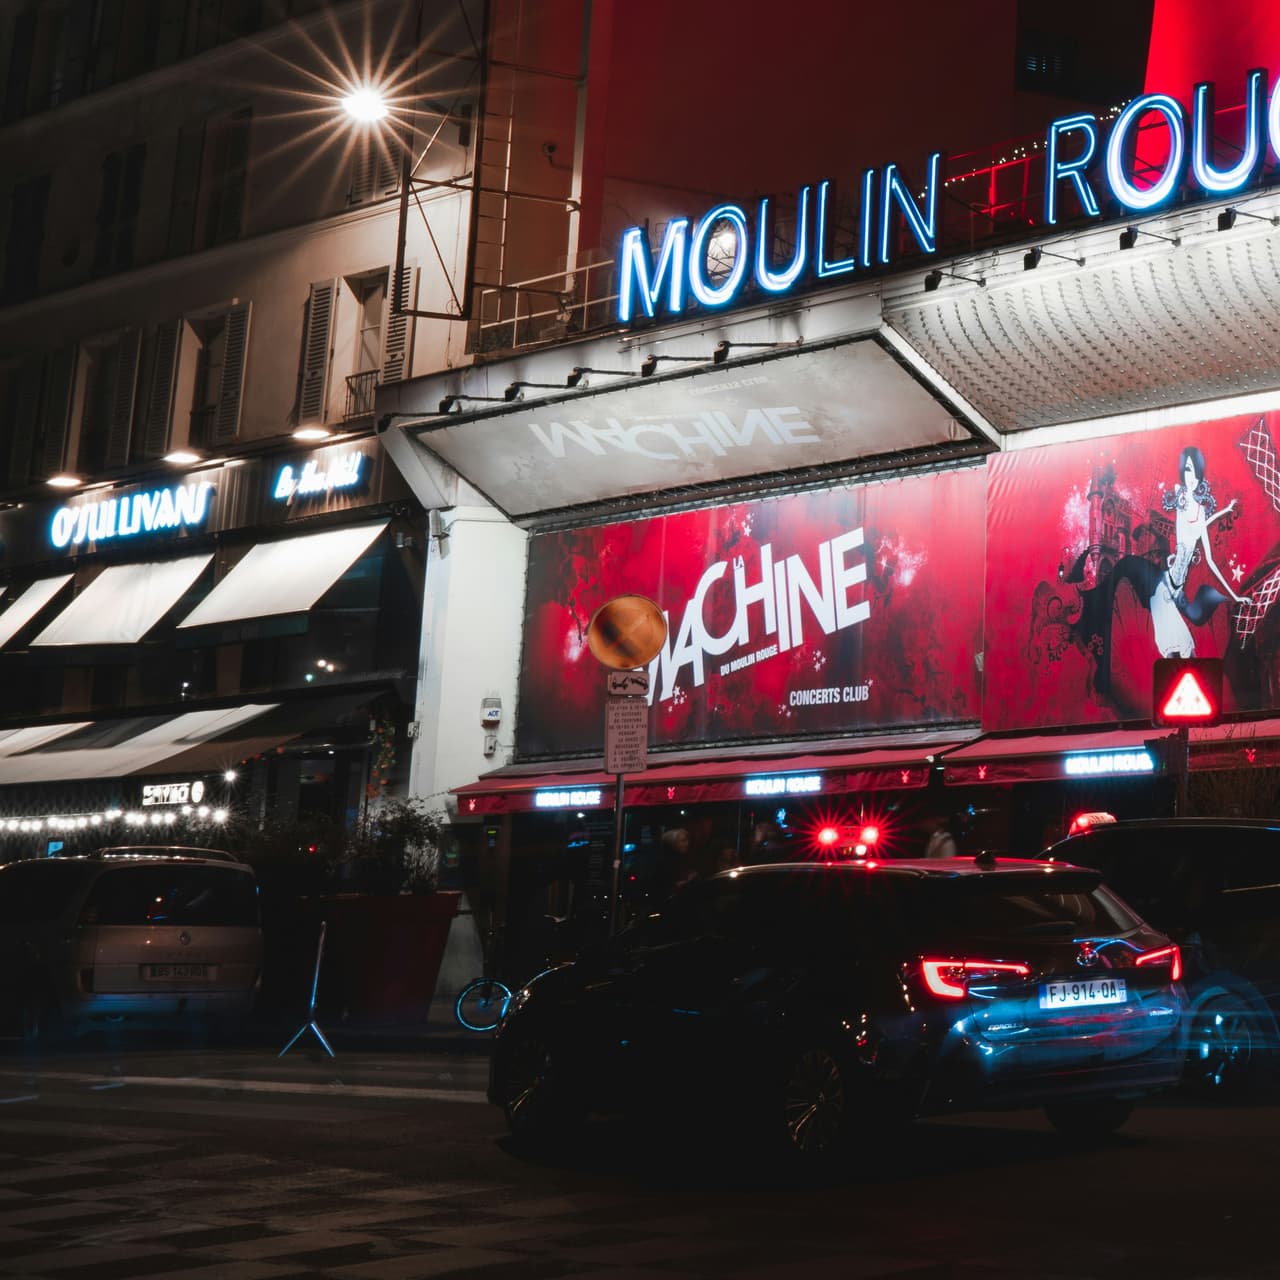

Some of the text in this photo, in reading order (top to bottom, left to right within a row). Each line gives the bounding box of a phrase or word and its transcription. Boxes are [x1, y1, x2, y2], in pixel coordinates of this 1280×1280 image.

[618, 152, 940, 321] MOULIN
[731, 653, 755, 672] MOULIN
[756, 644, 779, 663] ROUGE
[789, 685, 870, 707] CONCERTS CLUB
